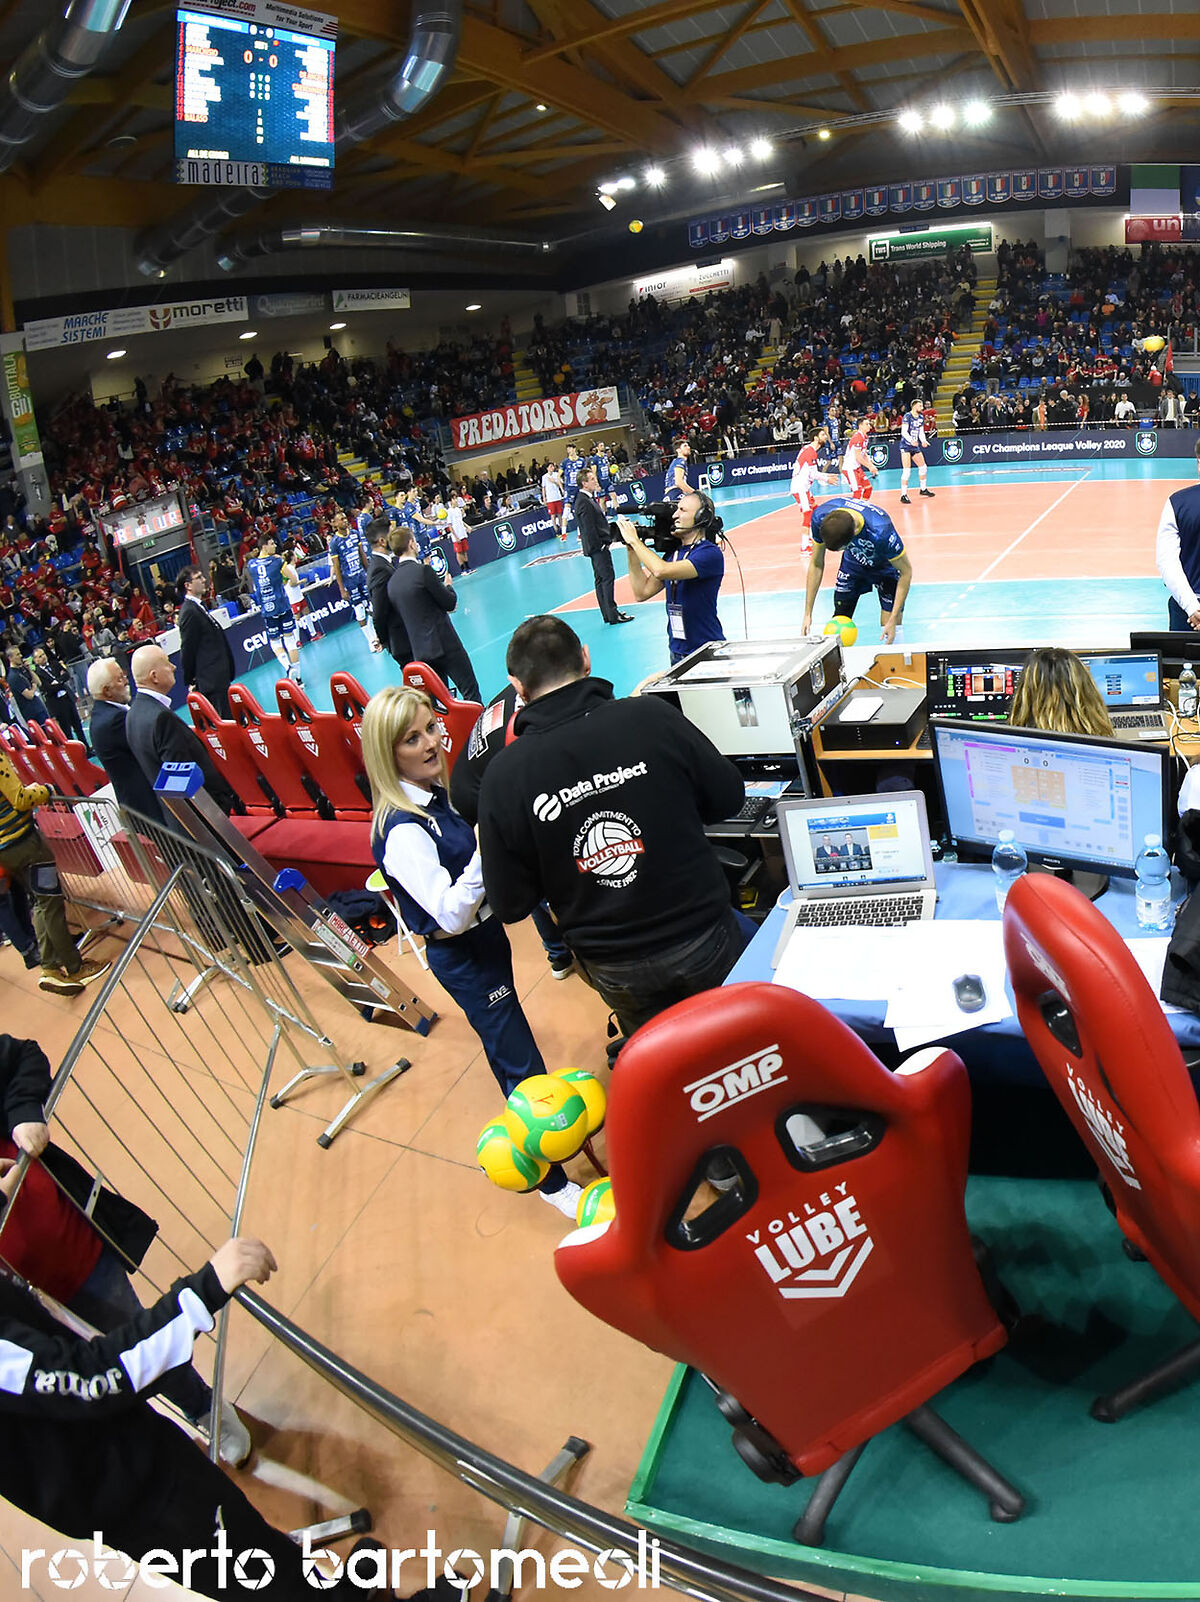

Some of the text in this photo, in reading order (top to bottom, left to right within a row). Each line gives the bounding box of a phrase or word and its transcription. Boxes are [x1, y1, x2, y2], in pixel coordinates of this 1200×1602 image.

[266, 3, 324, 23] Multimedia Solutions
[275, 14, 285, 22] for
[243, 49, 253, 64] 0
[268, 54, 278, 68] 0
[188, 160, 259, 185] madeira
[906, 243, 921, 251] World
[922, 240, 947, 250] Shipping
[172, 296, 243, 319] moretti
[63, 312, 109, 330] MARCHE
[60, 326, 106, 343] SISTEMI
[4, 354, 20, 400] BUTTALA
[458, 395, 575, 448] PREDATORS
[972, 439, 1126, 455] CEV Champions League Volley 2020
[732, 463, 788, 477] CEV Champions
[521, 524, 538, 537] CEV
[257, 564, 267, 578] 9
[243, 632, 268, 652] CEV
[559, 761, 648, 804] Data Project
[573, 834, 585, 857] TOTAL
[580, 810, 633, 834] COMMITMENT
[579, 841, 643, 871] VOLLEYBALL
[599, 871, 636, 889] SINCE 1982
[689, 1051, 784, 1113] OMP
[1065, 1062, 1126, 1135] VOLLEY
[1067, 1076, 1131, 1167] LUBE
[745, 1181, 850, 1246] VOLLEY
[754, 1195, 868, 1285] LUBE
